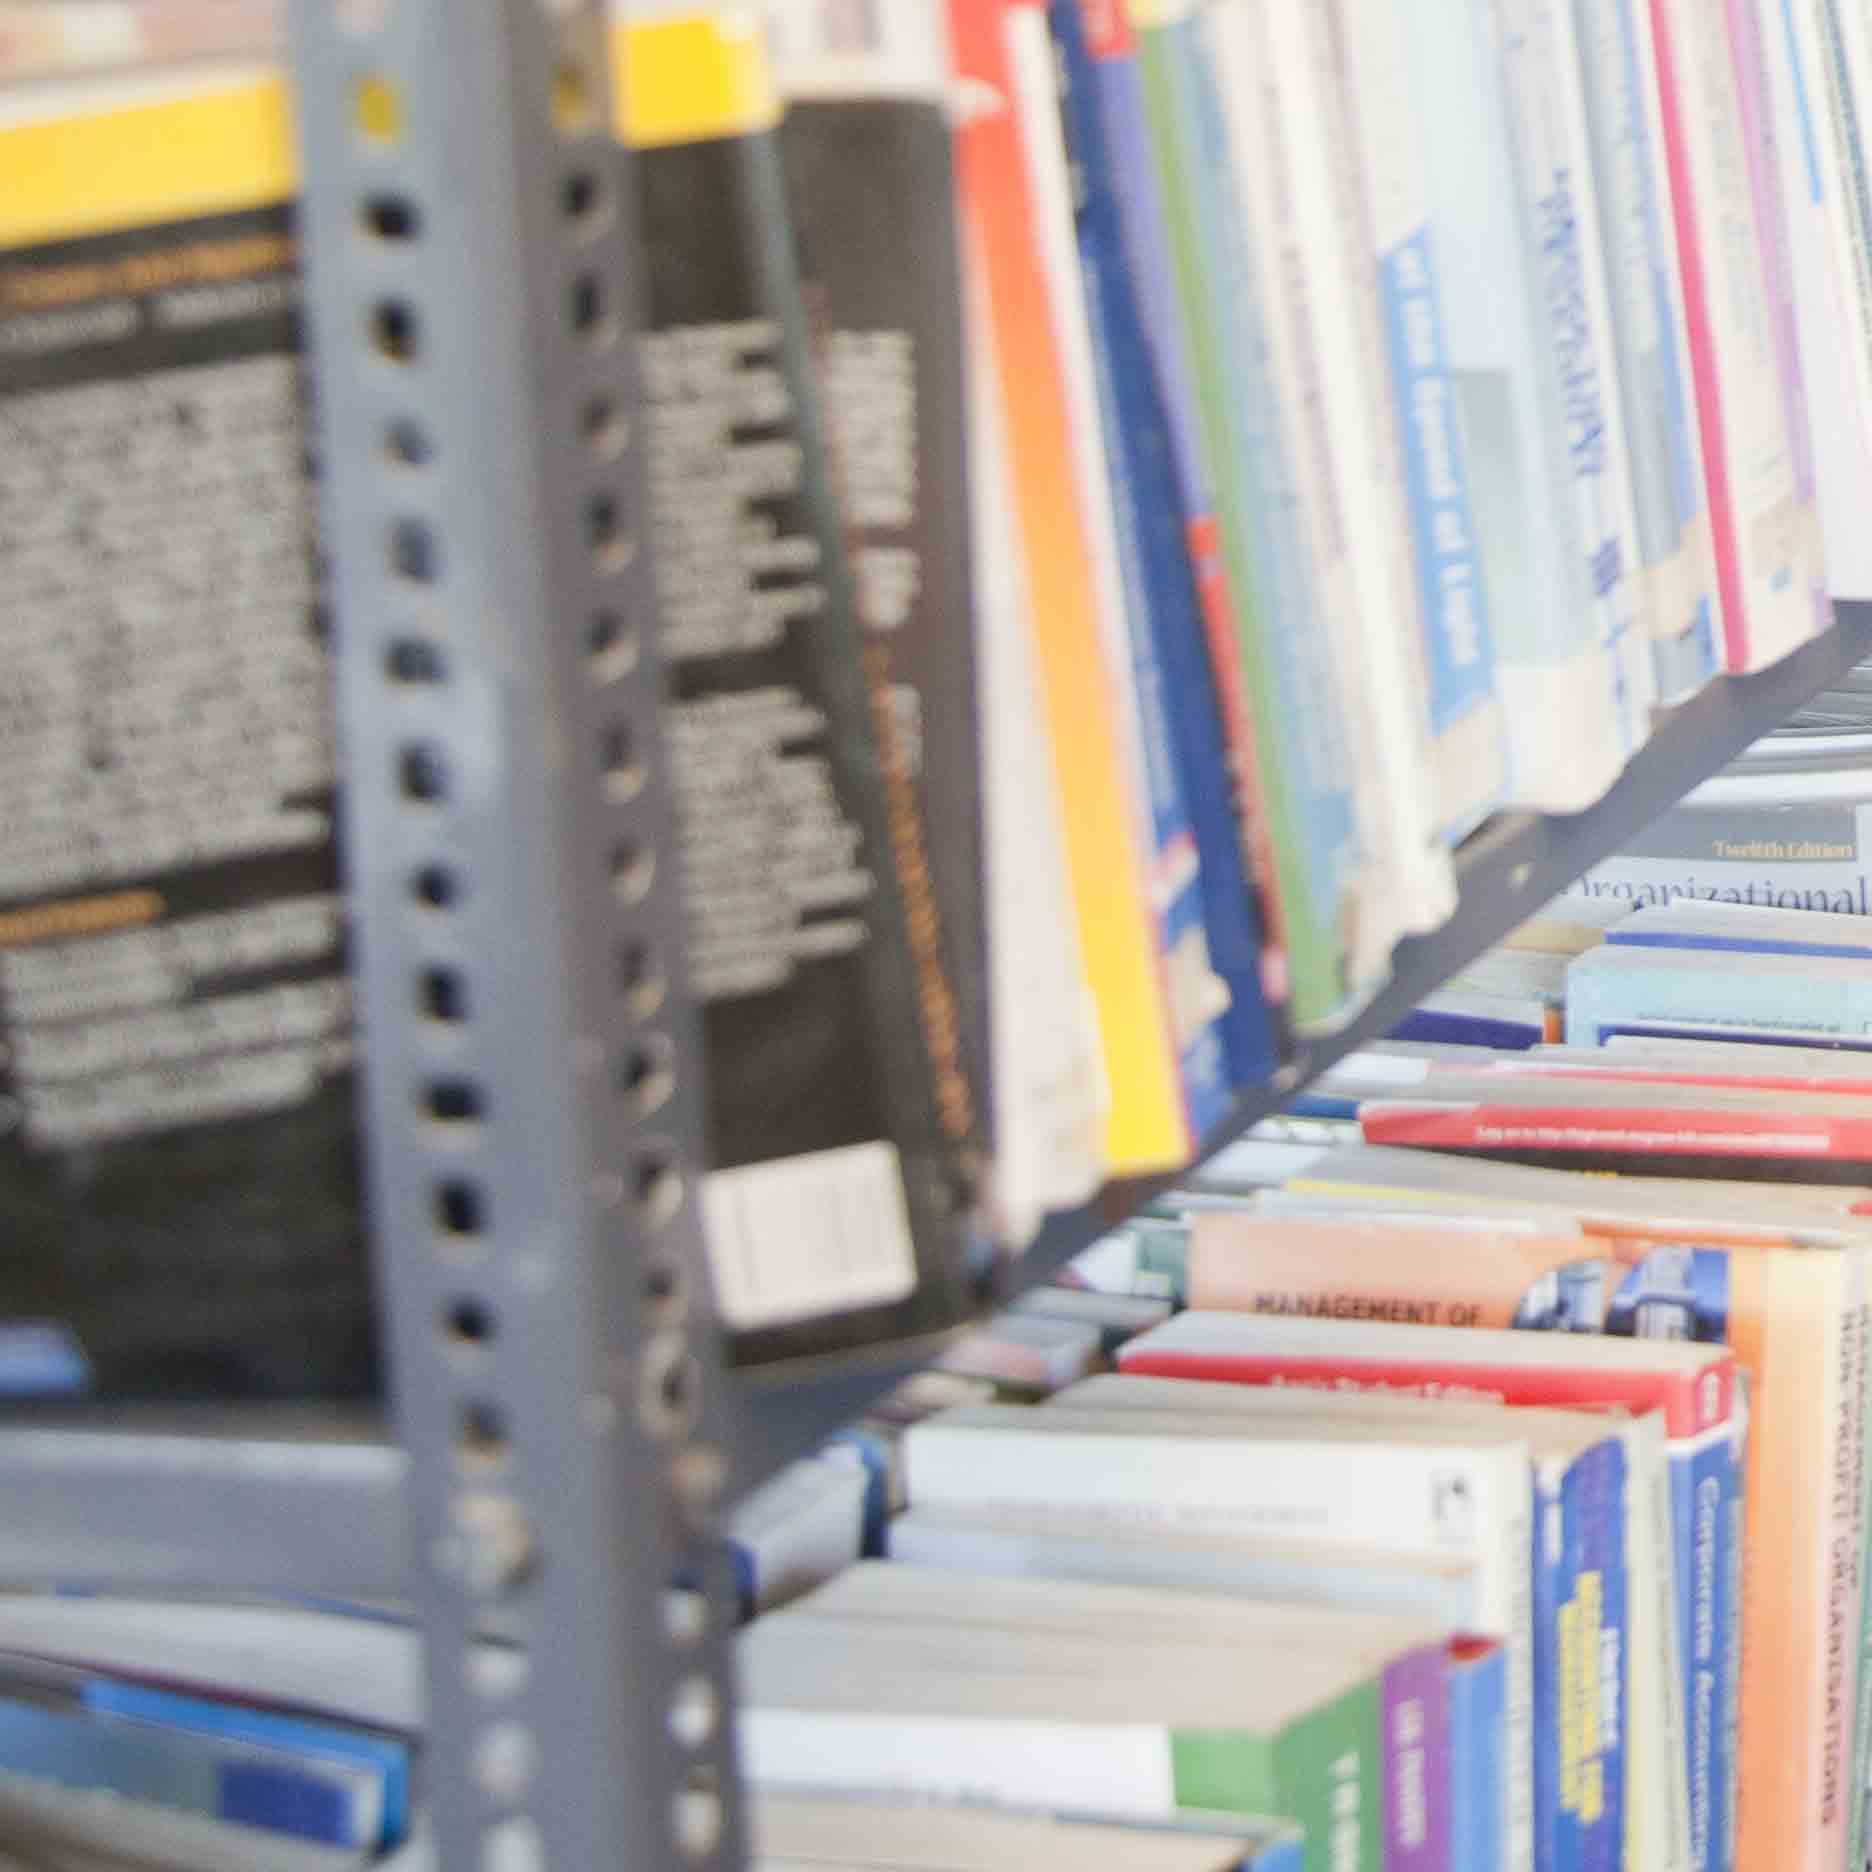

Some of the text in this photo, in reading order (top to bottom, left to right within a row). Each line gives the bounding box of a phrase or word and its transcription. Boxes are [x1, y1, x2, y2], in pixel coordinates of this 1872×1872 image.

[1713, 841, 1854, 860] Twelfth Edition
[1256, 1293, 1485, 1329] MANAGEMENT OF
[1695, 1476, 1722, 1660] Corporate
[1819, 1534, 1852, 1829] ORGANISATIONS
